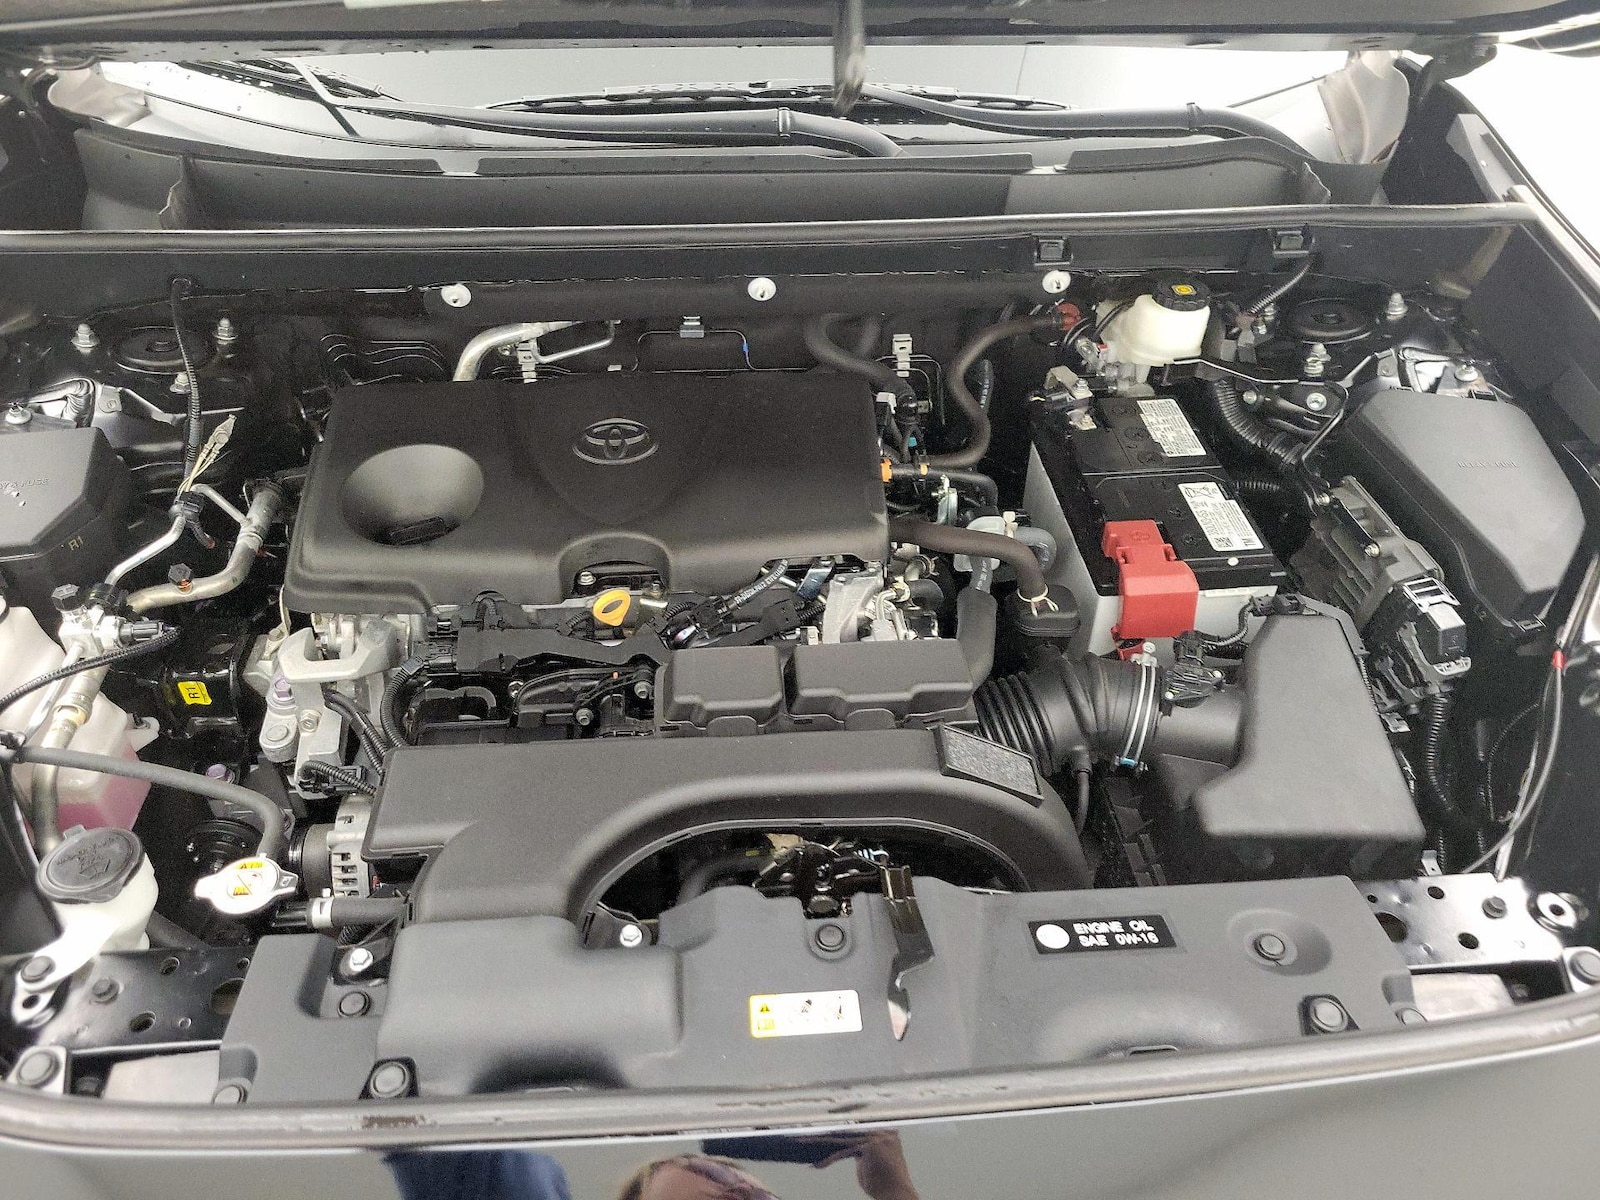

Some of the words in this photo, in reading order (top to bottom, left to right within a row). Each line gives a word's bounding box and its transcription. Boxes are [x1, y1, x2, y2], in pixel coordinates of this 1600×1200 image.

[1073, 921, 1125, 935] ENGINE
[1128, 919, 1154, 932] OIL
[1078, 935, 1109, 948] SAE
